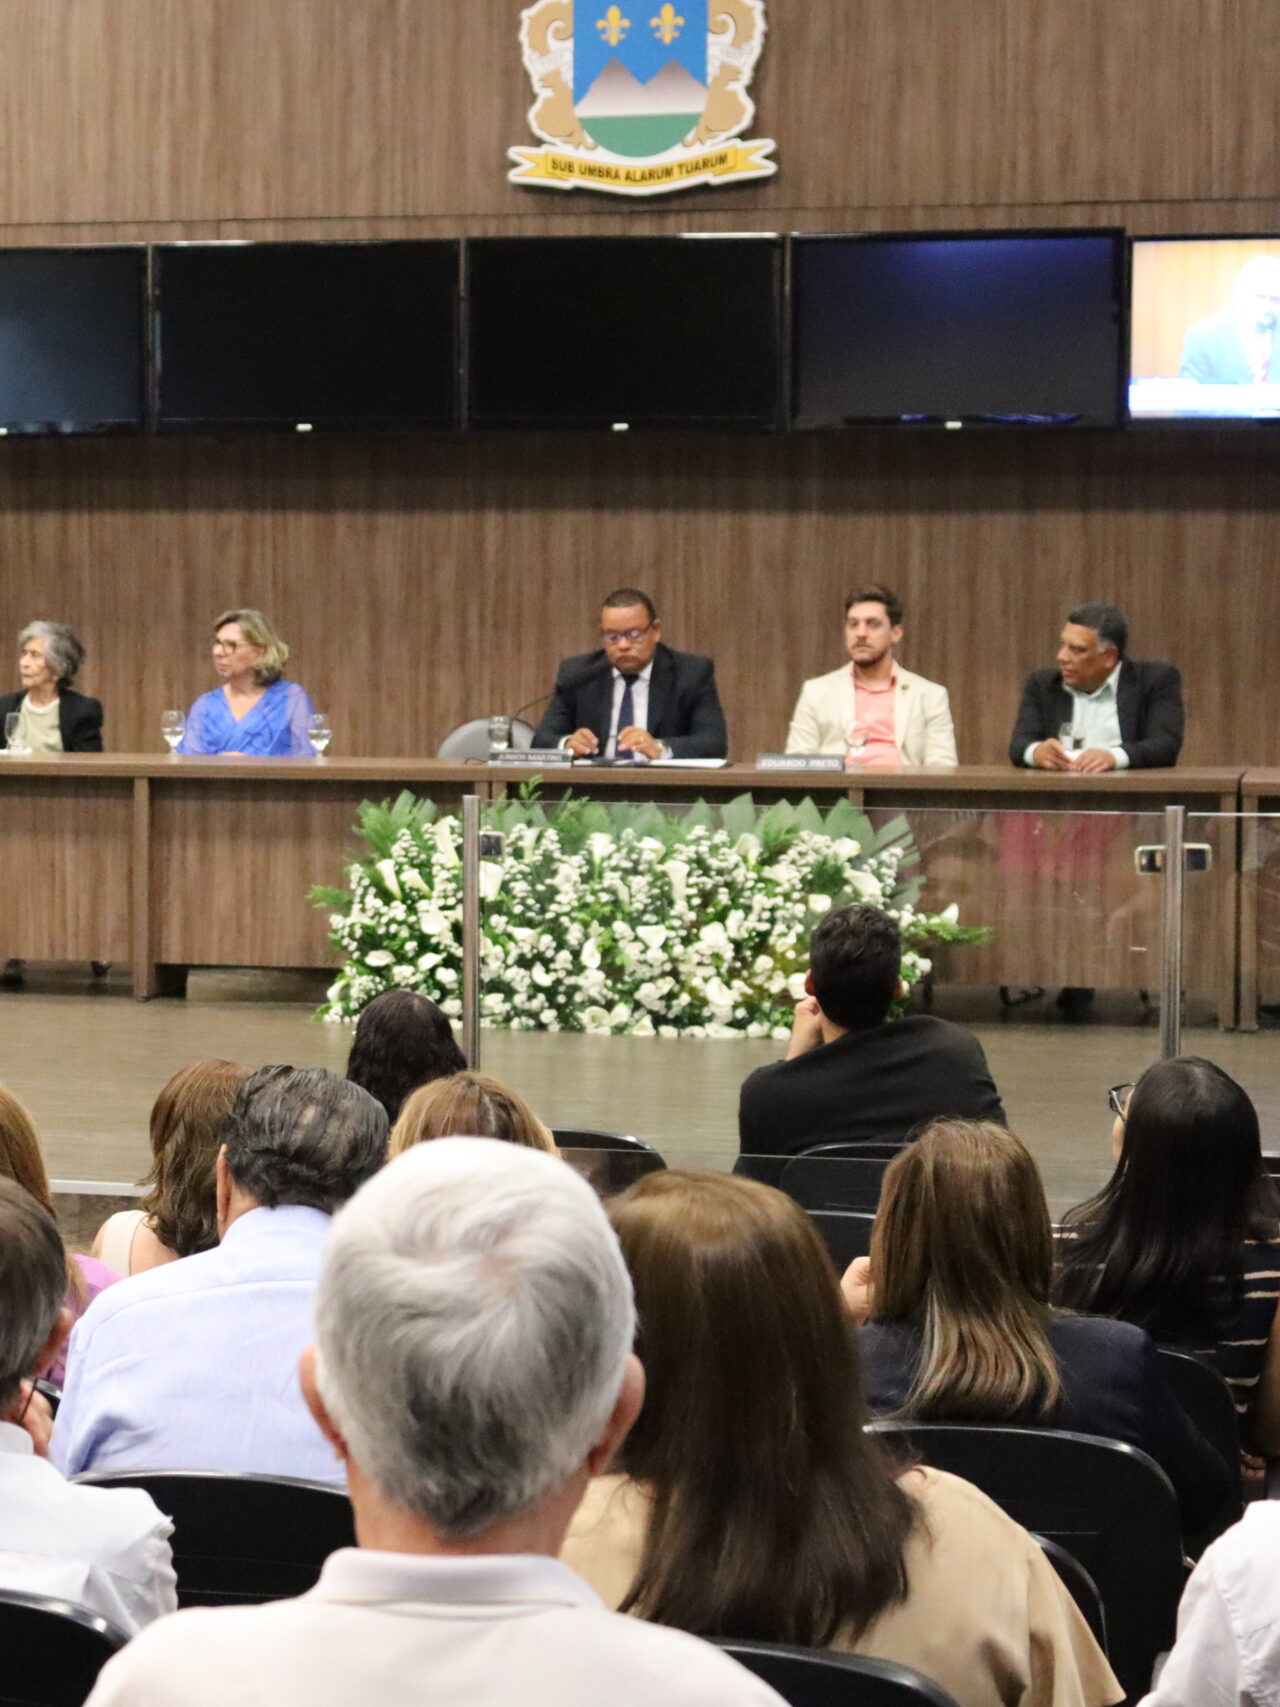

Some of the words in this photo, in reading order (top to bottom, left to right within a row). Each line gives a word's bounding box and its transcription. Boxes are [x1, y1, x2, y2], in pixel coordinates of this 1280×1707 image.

[551, 158, 575, 173] SUB
[579, 163, 621, 180] UMBRA
[624, 165, 674, 182] ALARUM
[677, 153, 728, 175] TUARUM
[761, 758, 806, 767] EDUARDO
[809, 758, 840, 767] PRETO
